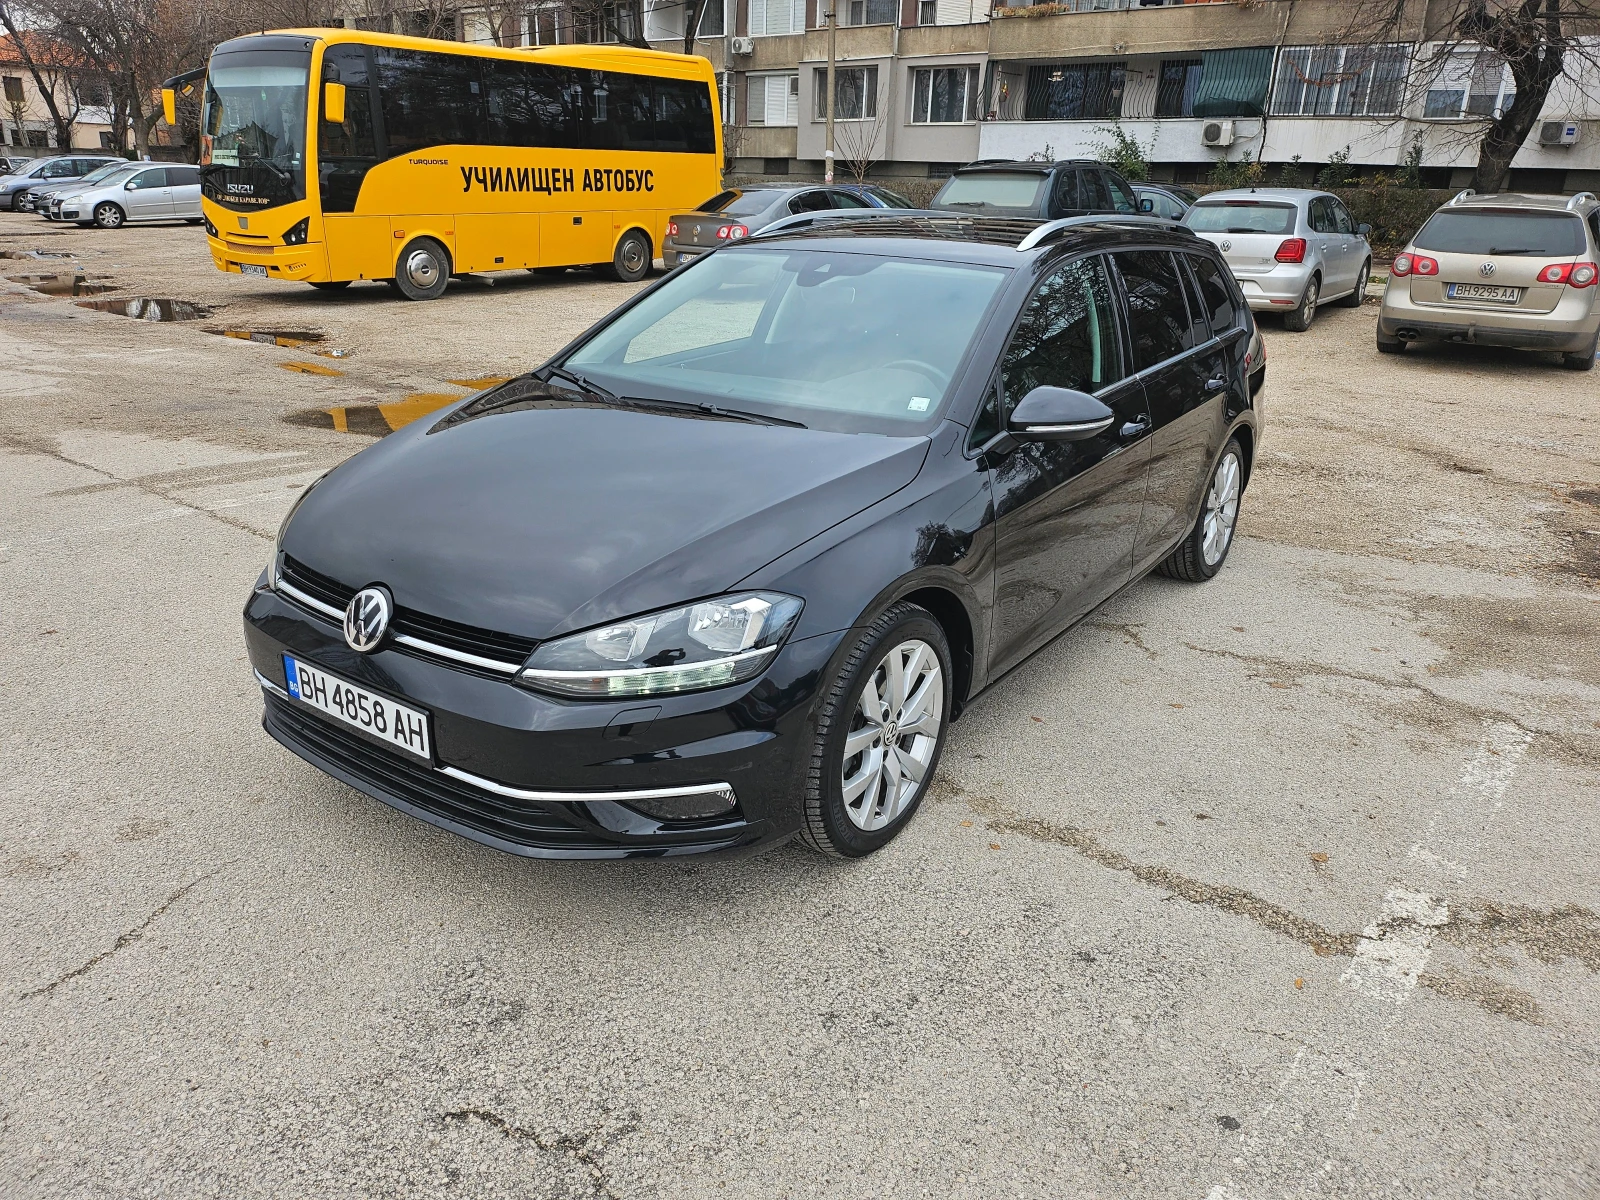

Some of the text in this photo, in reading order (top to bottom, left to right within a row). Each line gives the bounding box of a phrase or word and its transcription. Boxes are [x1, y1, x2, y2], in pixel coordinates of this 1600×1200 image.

[408, 158, 449, 166] TURQUOISE
[460, 166, 655, 196] УЧИЛИЩЕН АВТОБУС
[227, 184, 254, 194] ISUZU
[1500, 288, 1516, 299] AA
[289, 680, 299, 692] BG
[298, 666, 425, 752] BH 4858 AH
